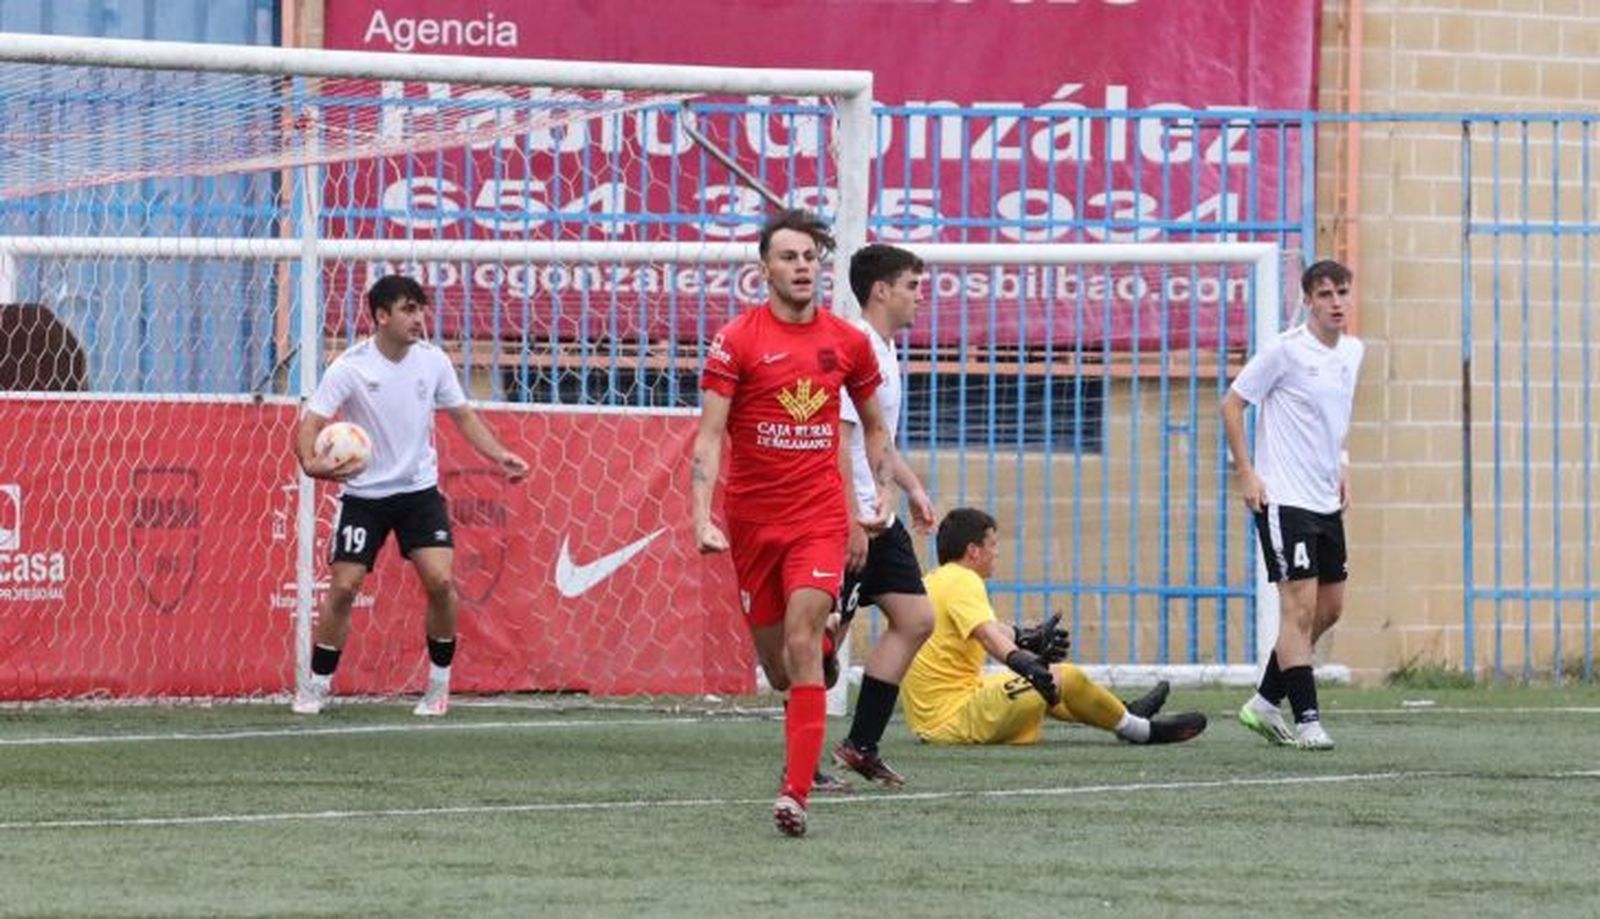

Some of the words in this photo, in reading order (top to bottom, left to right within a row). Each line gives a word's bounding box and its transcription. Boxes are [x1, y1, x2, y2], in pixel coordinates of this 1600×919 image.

[364, 9, 519, 51] Agencia
[757, 421, 792, 436] CAJA
[342, 525, 367, 553] 19
[1293, 541, 1311, 570] 4
